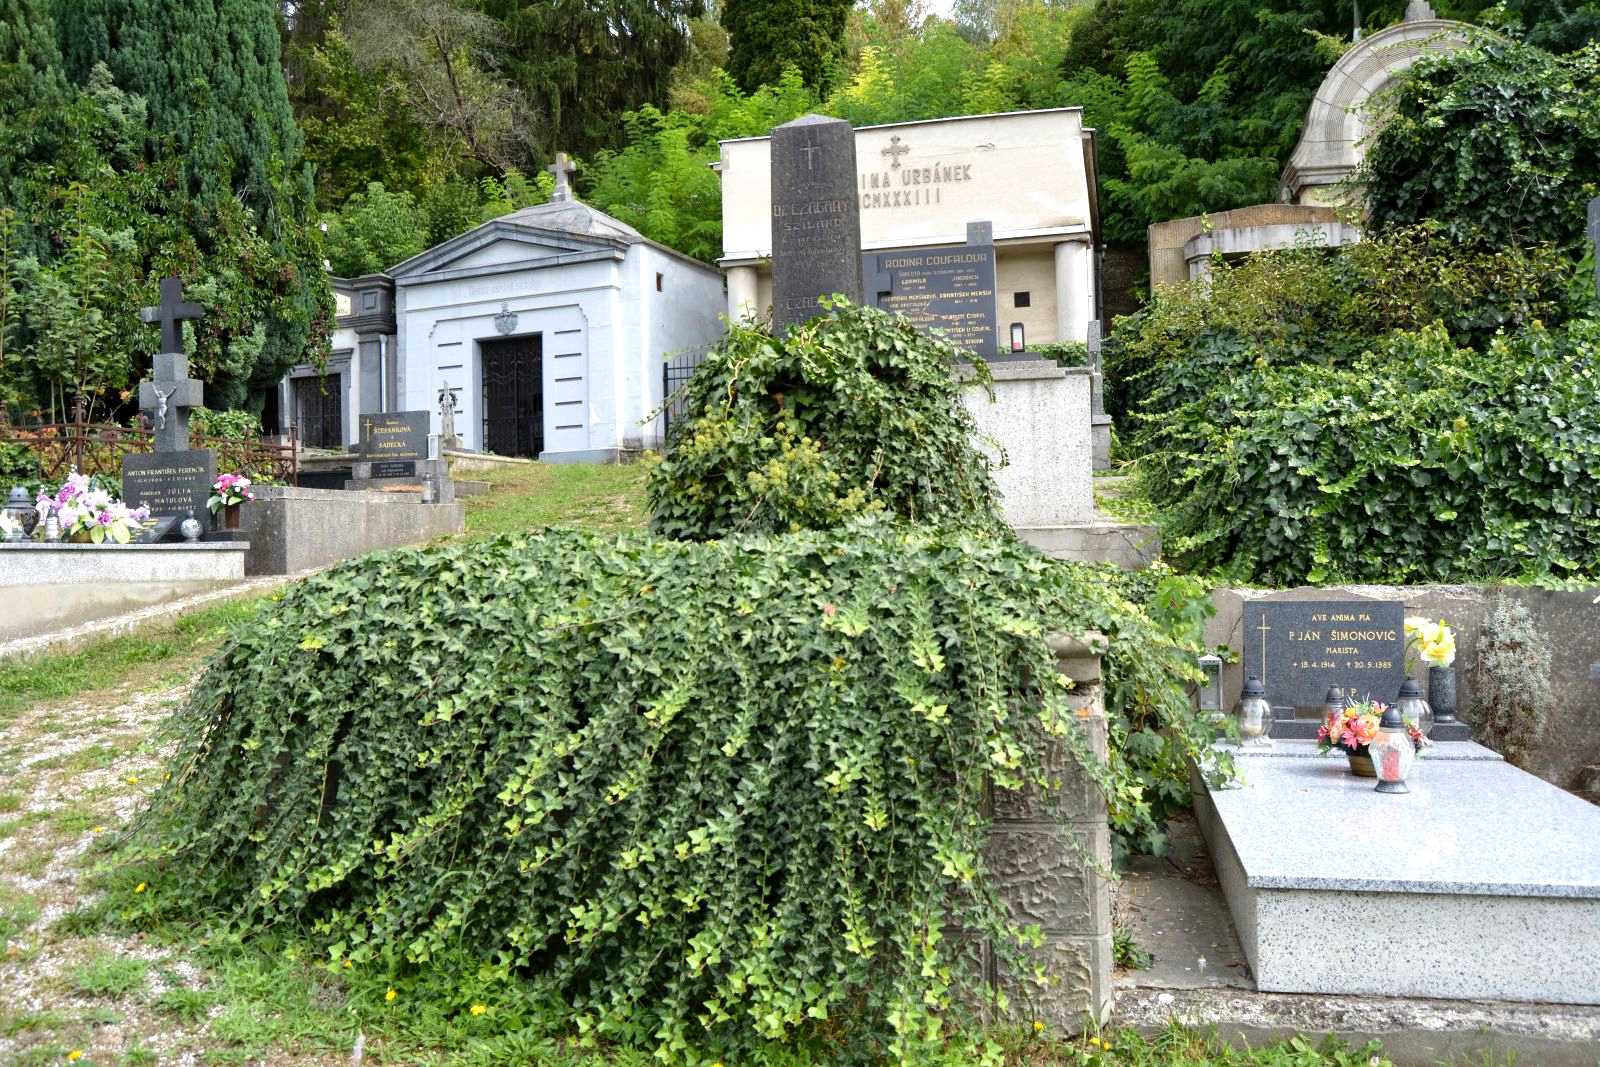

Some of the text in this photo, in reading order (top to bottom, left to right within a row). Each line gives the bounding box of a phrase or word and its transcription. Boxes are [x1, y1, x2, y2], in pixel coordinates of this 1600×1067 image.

[902, 162, 972, 186] URBÁNEK
[858, 187, 941, 209] CMXXXIII
[885, 257, 923, 269] RODINA
[147, 467, 177, 476] FRANTIŠEK
[1312, 614, 1371, 622] AVE ANIMA PIA
[1297, 630, 1321, 641] JÁN
